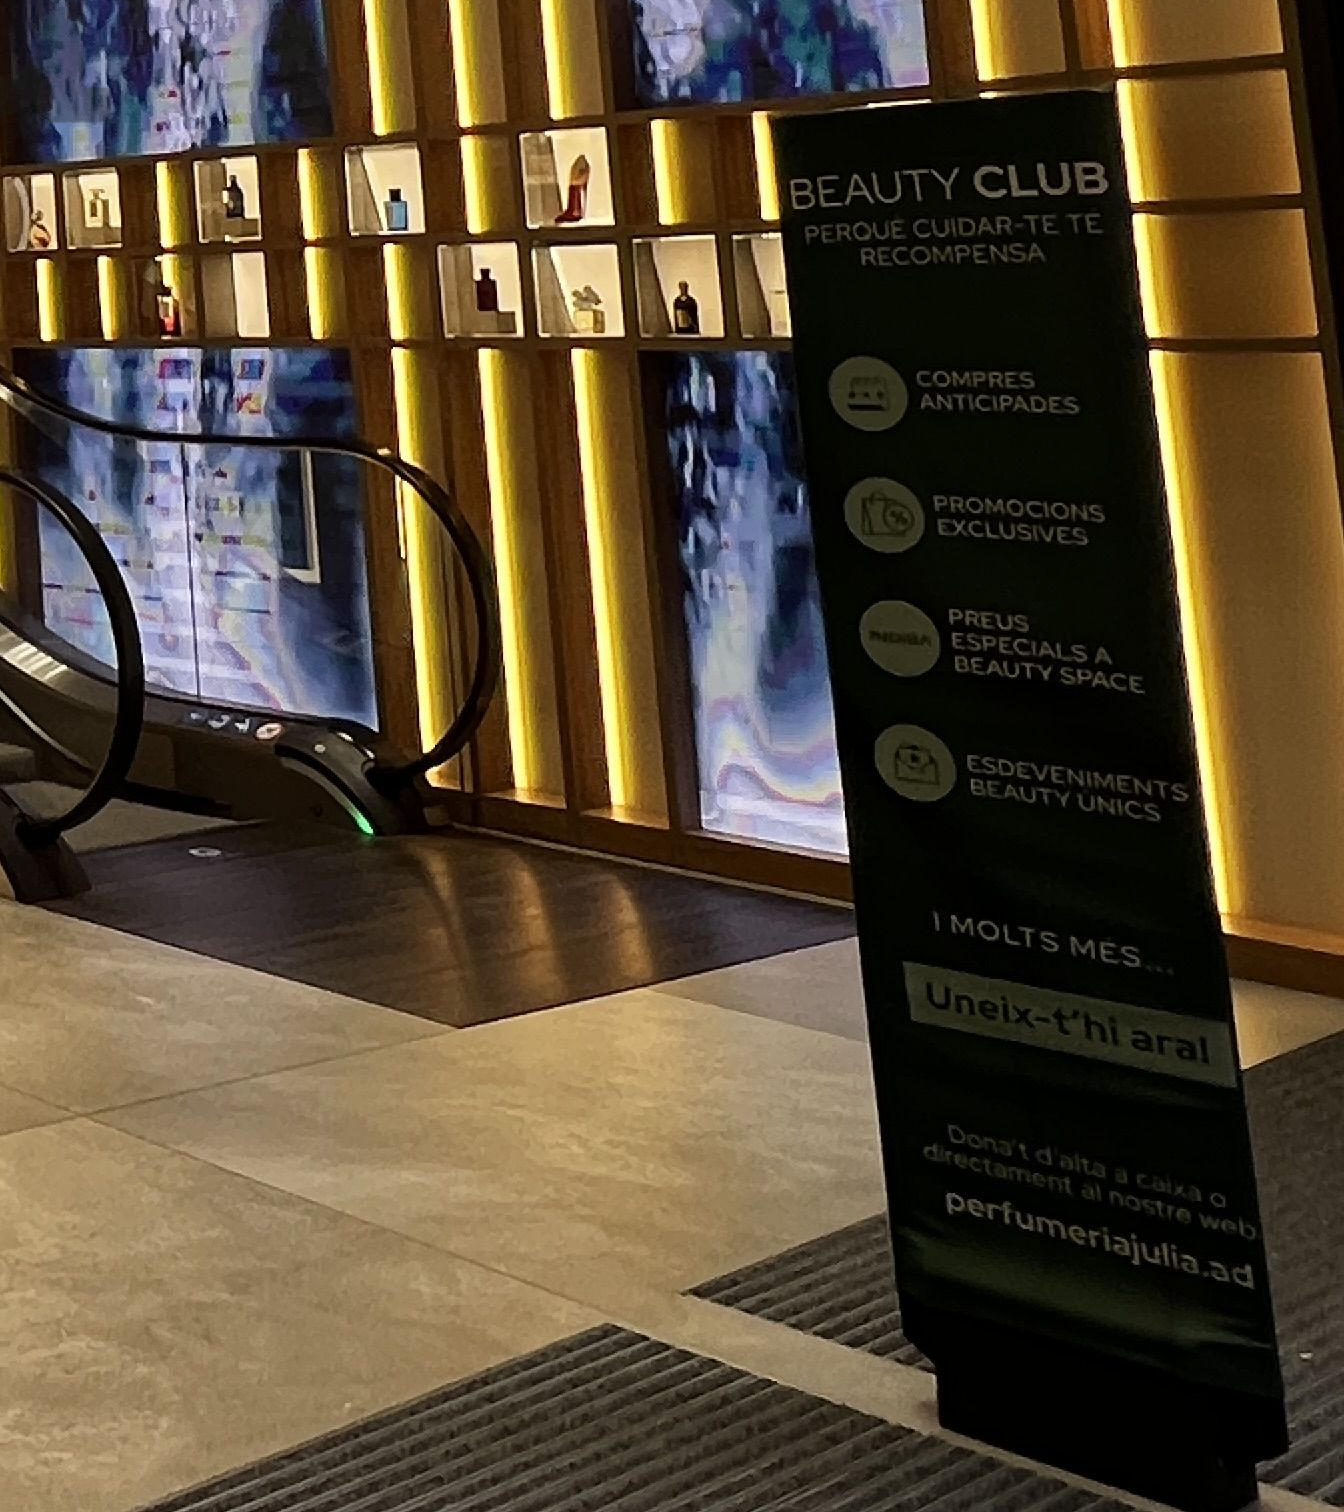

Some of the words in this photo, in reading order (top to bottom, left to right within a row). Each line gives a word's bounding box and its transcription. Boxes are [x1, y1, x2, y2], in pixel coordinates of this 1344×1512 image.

[789, 167, 960, 210] BEAUTY
[973, 161, 1110, 198] CLUB
[912, 214, 1059, 240] CUIDAR-TE
[860, 243, 1046, 267] RECOMPENSA
[915, 370, 1035, 389] COMPRES
[919, 394, 1080, 414] ANTICIPADES
[933, 495, 1106, 524] PROMOCIONS
[937, 519, 1089, 546] EXCLUSIVES
[948, 608, 1029, 632] PREUS
[951, 633, 1088, 662] ESPECIALS
[1094, 647, 1112, 665] A
[954, 657, 1051, 681] BEAUTY
[1060, 667, 1145, 694] SPACE
[967, 755, 1189, 802] ESDEVENIMENTS
[969, 778, 1069, 808] BEAUTY
[933, 911, 940, 931] I
[950, 915, 1059, 953] MOLTS
[923, 1144, 1072, 1196] directament
[1081, 1178, 1102, 1201] al
[1109, 1189, 1192, 1225] nostre
[1199, 1209, 1258, 1240] web
[1136, 1170, 1202, 1203] caixa
[1211, 1192, 1227, 1209] o
[945, 1191, 1255, 1289] perfumeriajulia.ad
